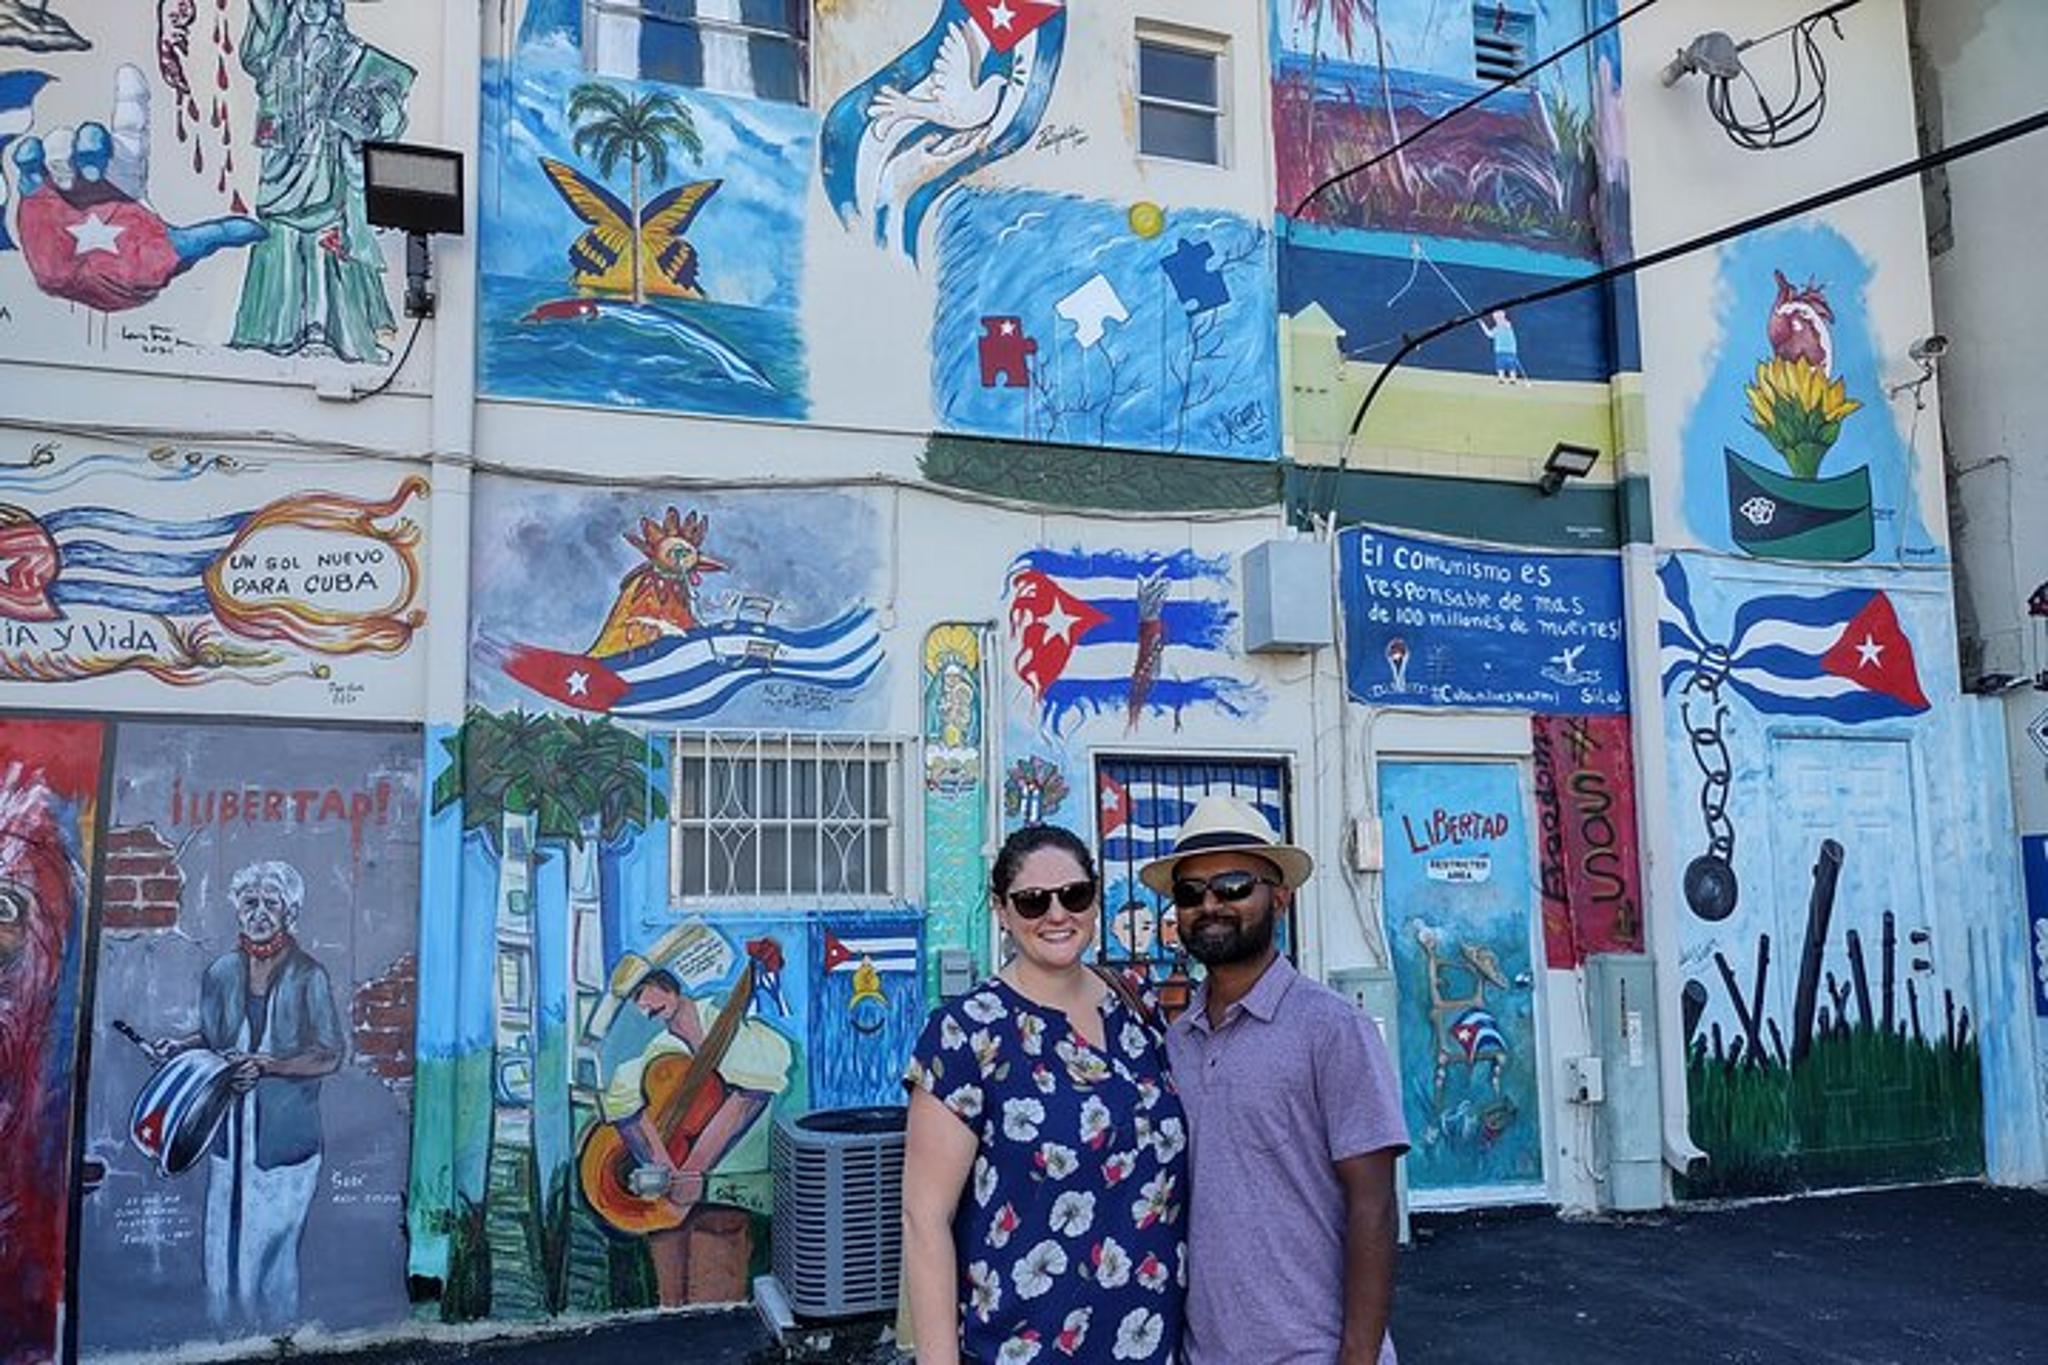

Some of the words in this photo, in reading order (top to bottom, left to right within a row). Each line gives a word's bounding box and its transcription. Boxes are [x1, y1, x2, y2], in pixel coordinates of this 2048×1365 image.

[230, 554, 257, 570] UN
[265, 556, 301, 571] SOL
[317, 548, 385, 568] NUEVO
[1360, 535, 1384, 567] El
[1520, 563, 1552, 588] es
[232, 576, 290, 596] PARA
[303, 571, 379, 595] CUBA
[1498, 590, 1525, 613] de
[1367, 602, 1391, 625] de
[1395, 606, 1424, 627] 100
[0, 618, 39, 648] iA
